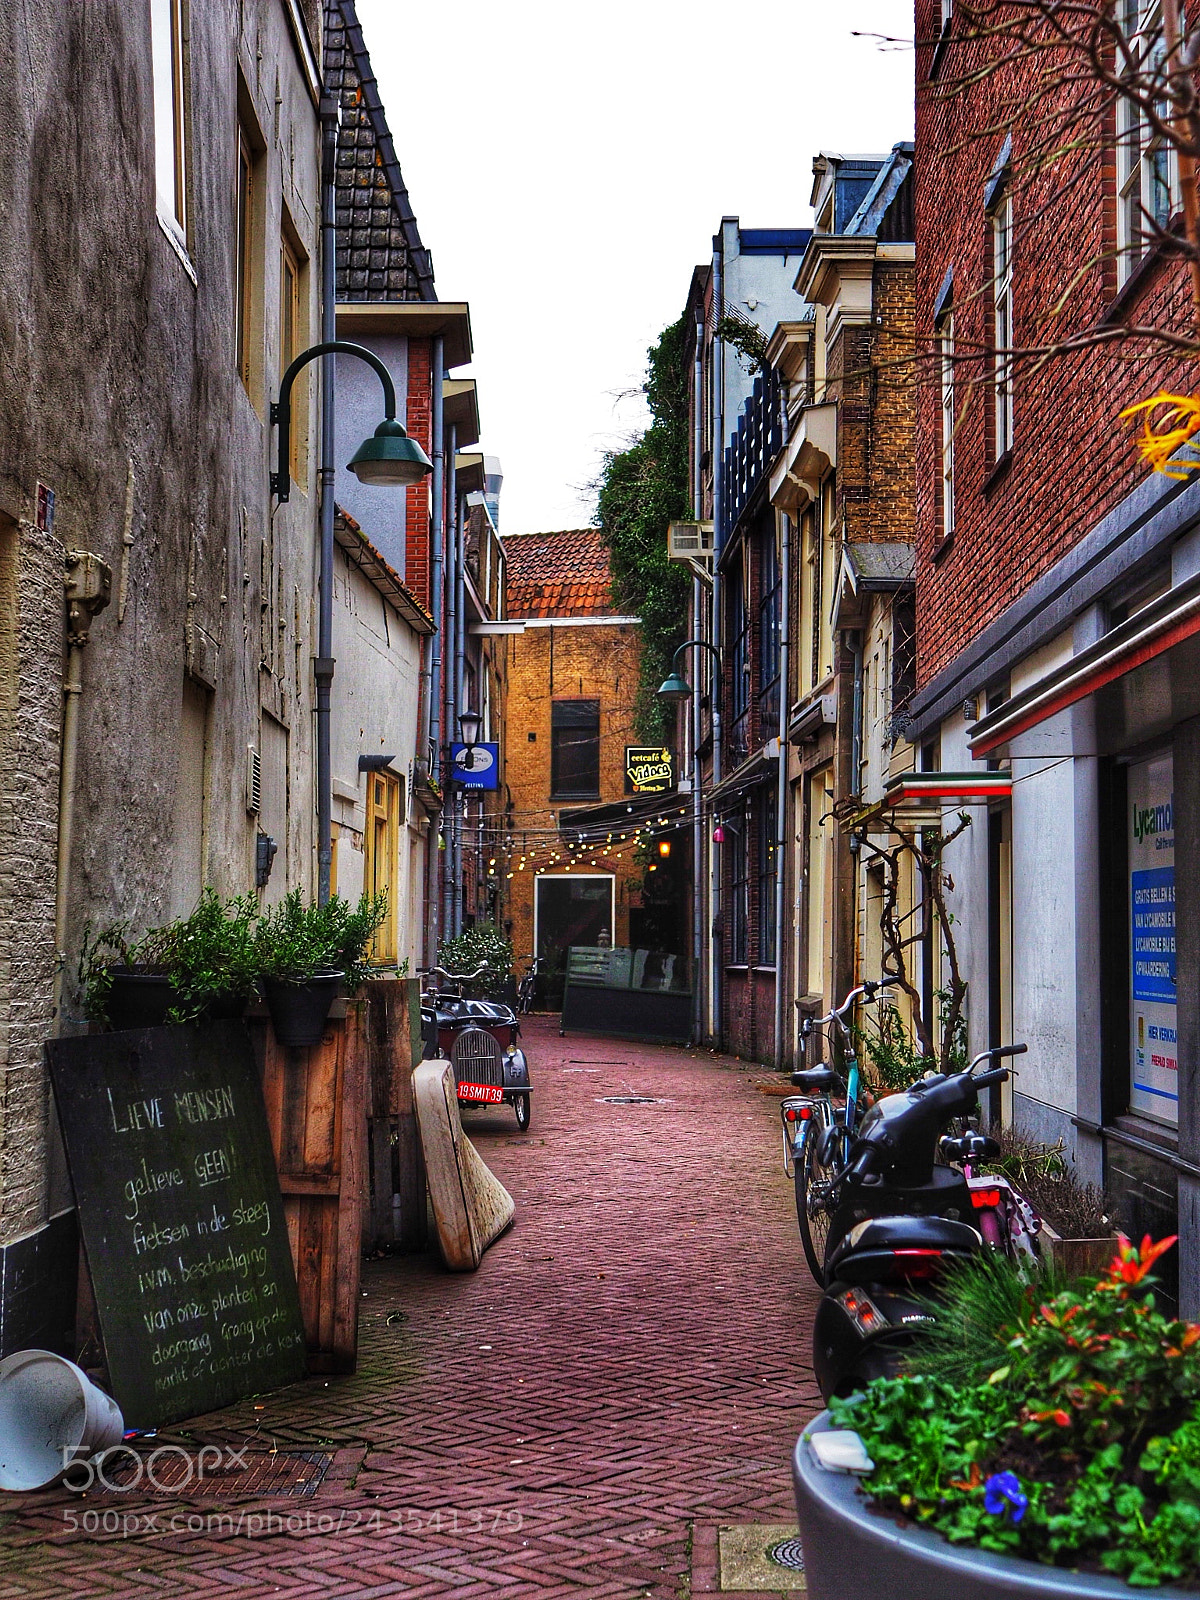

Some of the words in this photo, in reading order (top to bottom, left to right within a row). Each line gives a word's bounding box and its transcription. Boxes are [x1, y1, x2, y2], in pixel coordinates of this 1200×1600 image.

[631, 753, 660, 761] eetcafé
[174, 1085, 236, 1125] MENSEN
[124, 1157, 184, 1220] gelieve
[133, 1222, 190, 1255] fietsen
[232, 1198, 271, 1236] steeg
[177, 1298, 210, 1323] onze
[211, 1284, 258, 1321] planten
[262, 1281, 278, 1298] en
[152, 1332, 213, 1365] doorgang
